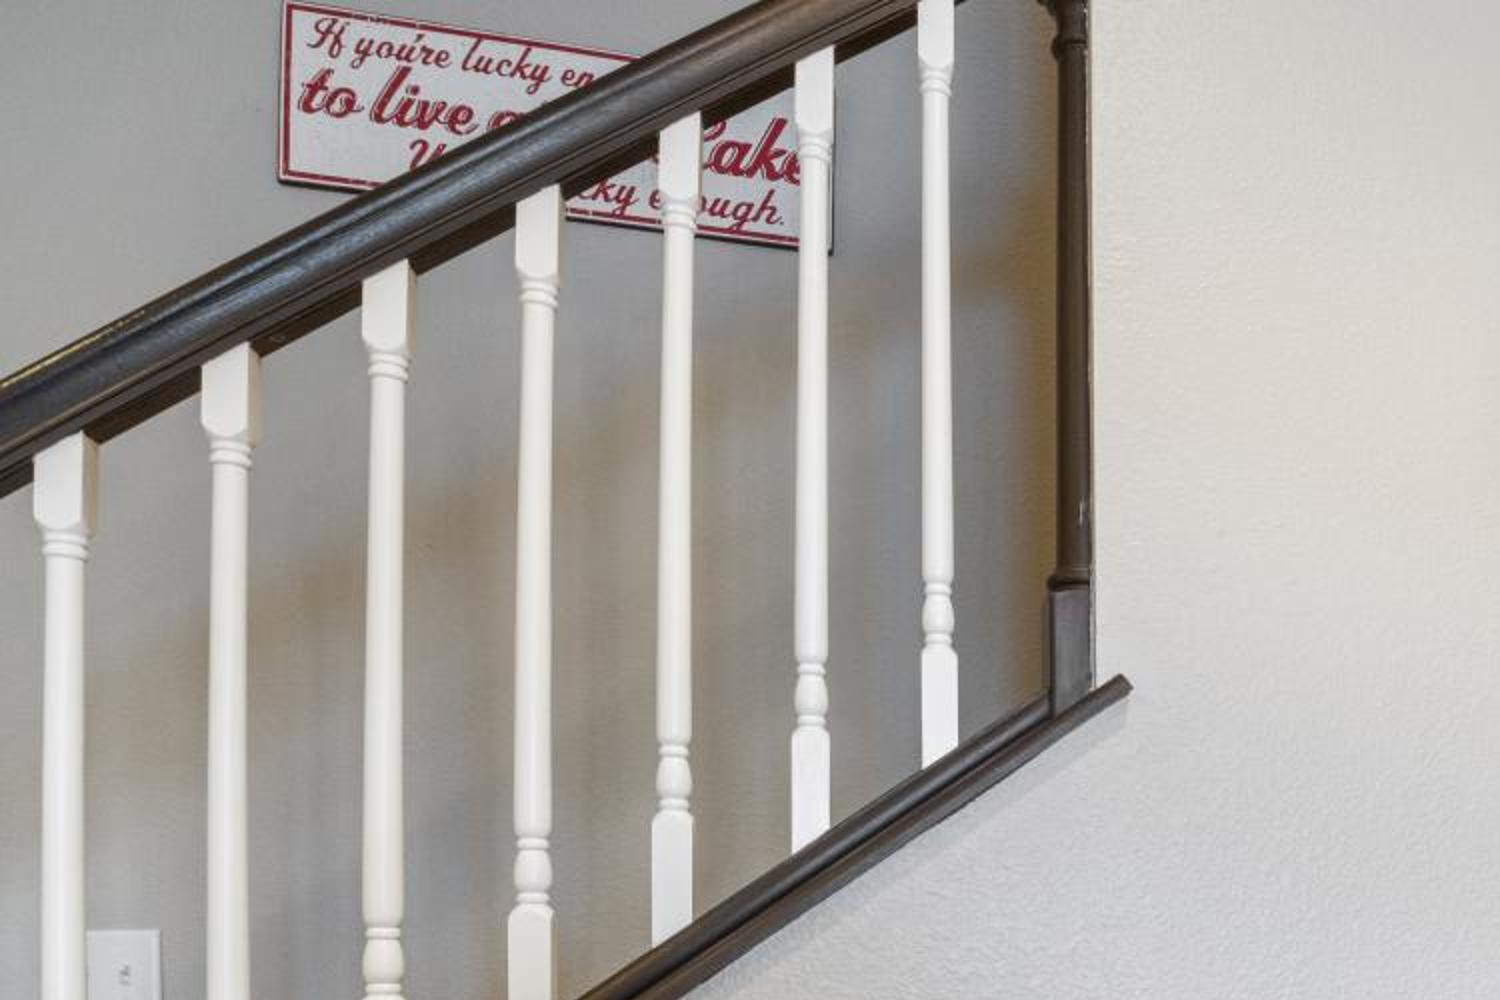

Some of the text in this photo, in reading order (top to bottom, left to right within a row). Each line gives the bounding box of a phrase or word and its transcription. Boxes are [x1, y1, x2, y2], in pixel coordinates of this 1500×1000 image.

[306, 17, 349, 58] If
[351, 34, 451, 69] you're
[461, 36, 552, 94] lucky
[298, 67, 364, 118] to
[369, 65, 479, 135] live
